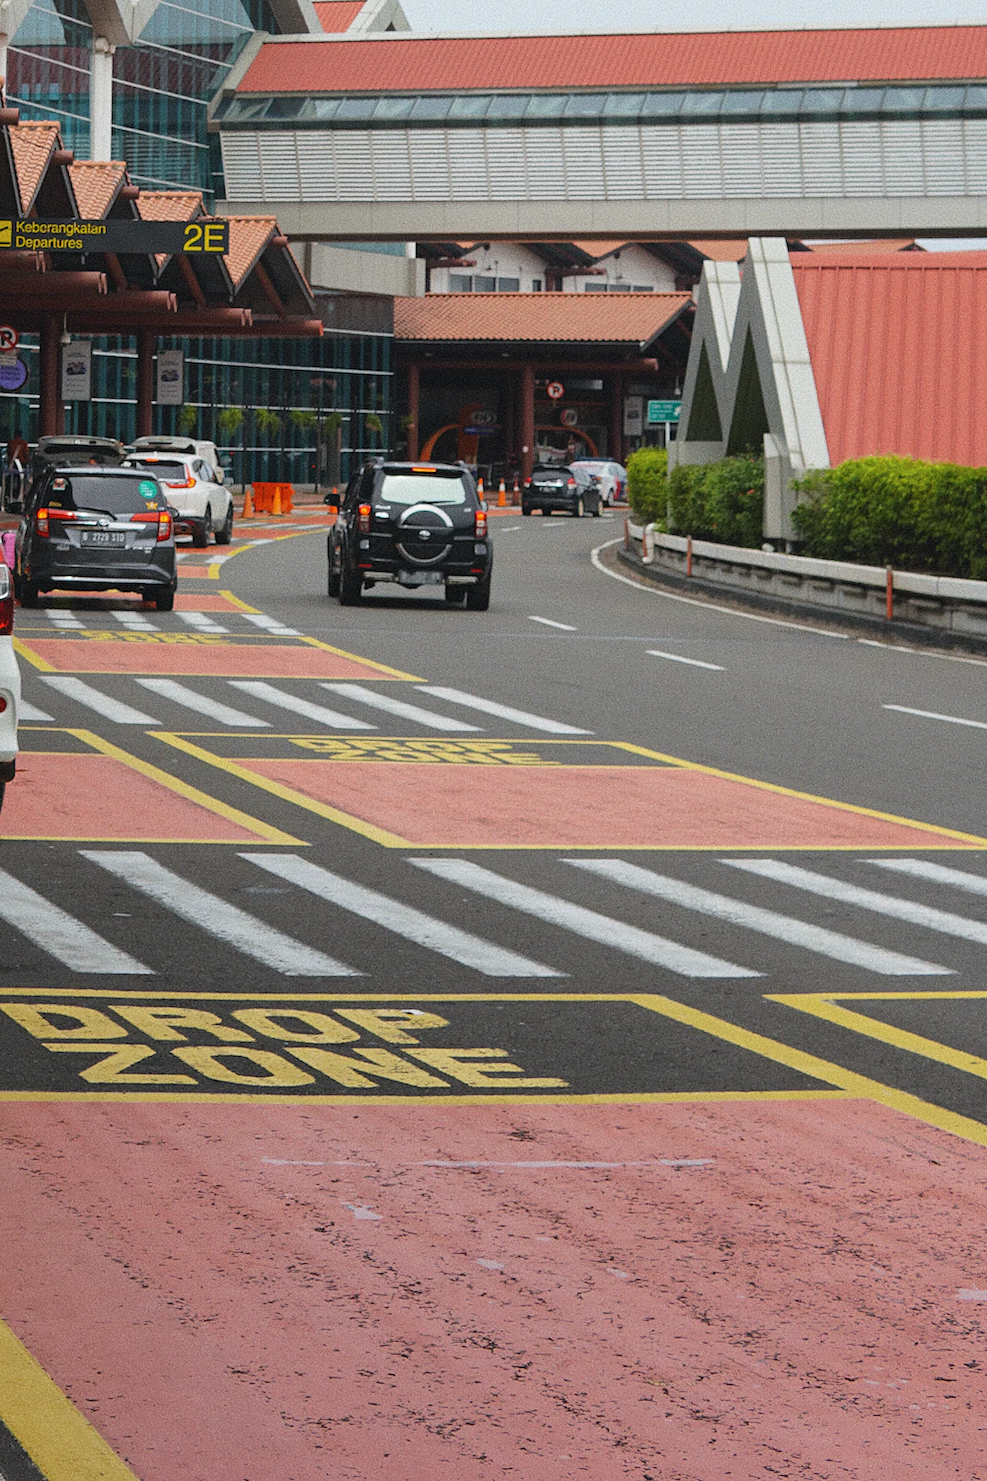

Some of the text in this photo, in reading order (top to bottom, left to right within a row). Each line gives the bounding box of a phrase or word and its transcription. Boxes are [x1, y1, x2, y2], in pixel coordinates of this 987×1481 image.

[15, 221, 106, 236] Keberangkatan
[183, 224, 225, 252] 2E
[15, 235, 83, 250] Departures
[41, 1041, 571, 1088] ZONE
